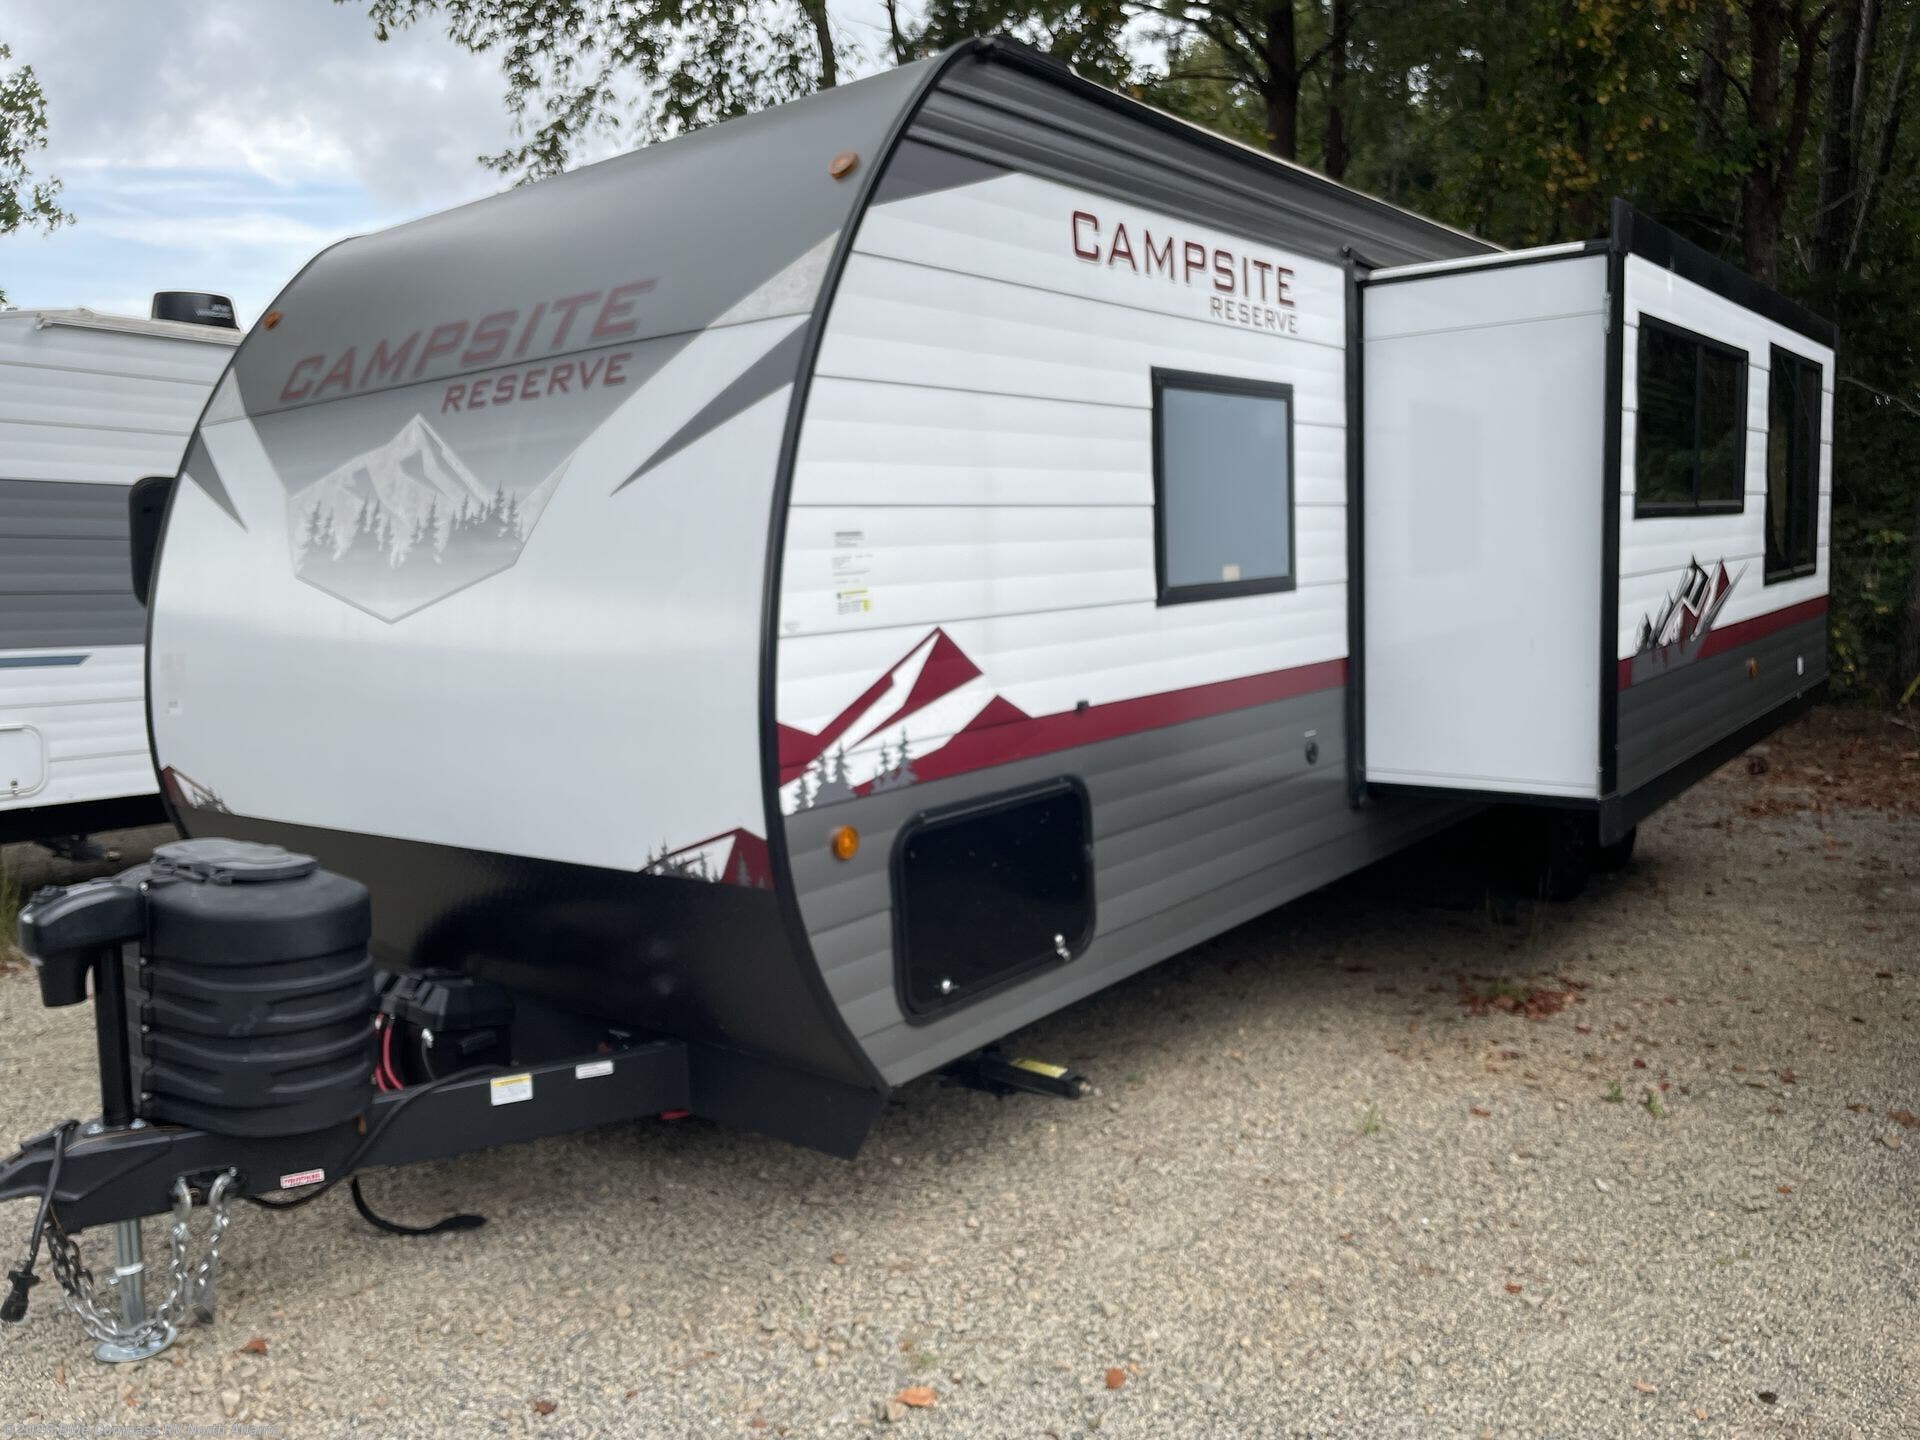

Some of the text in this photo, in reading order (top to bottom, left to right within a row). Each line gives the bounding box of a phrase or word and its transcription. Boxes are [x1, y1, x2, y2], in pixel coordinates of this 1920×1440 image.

[1072, 210, 1296, 307] CAMPSITE
[279, 277, 658, 403] CAMPSITE
[1209, 296, 1299, 335] RESERVE
[440, 351, 633, 415] RESERVE
